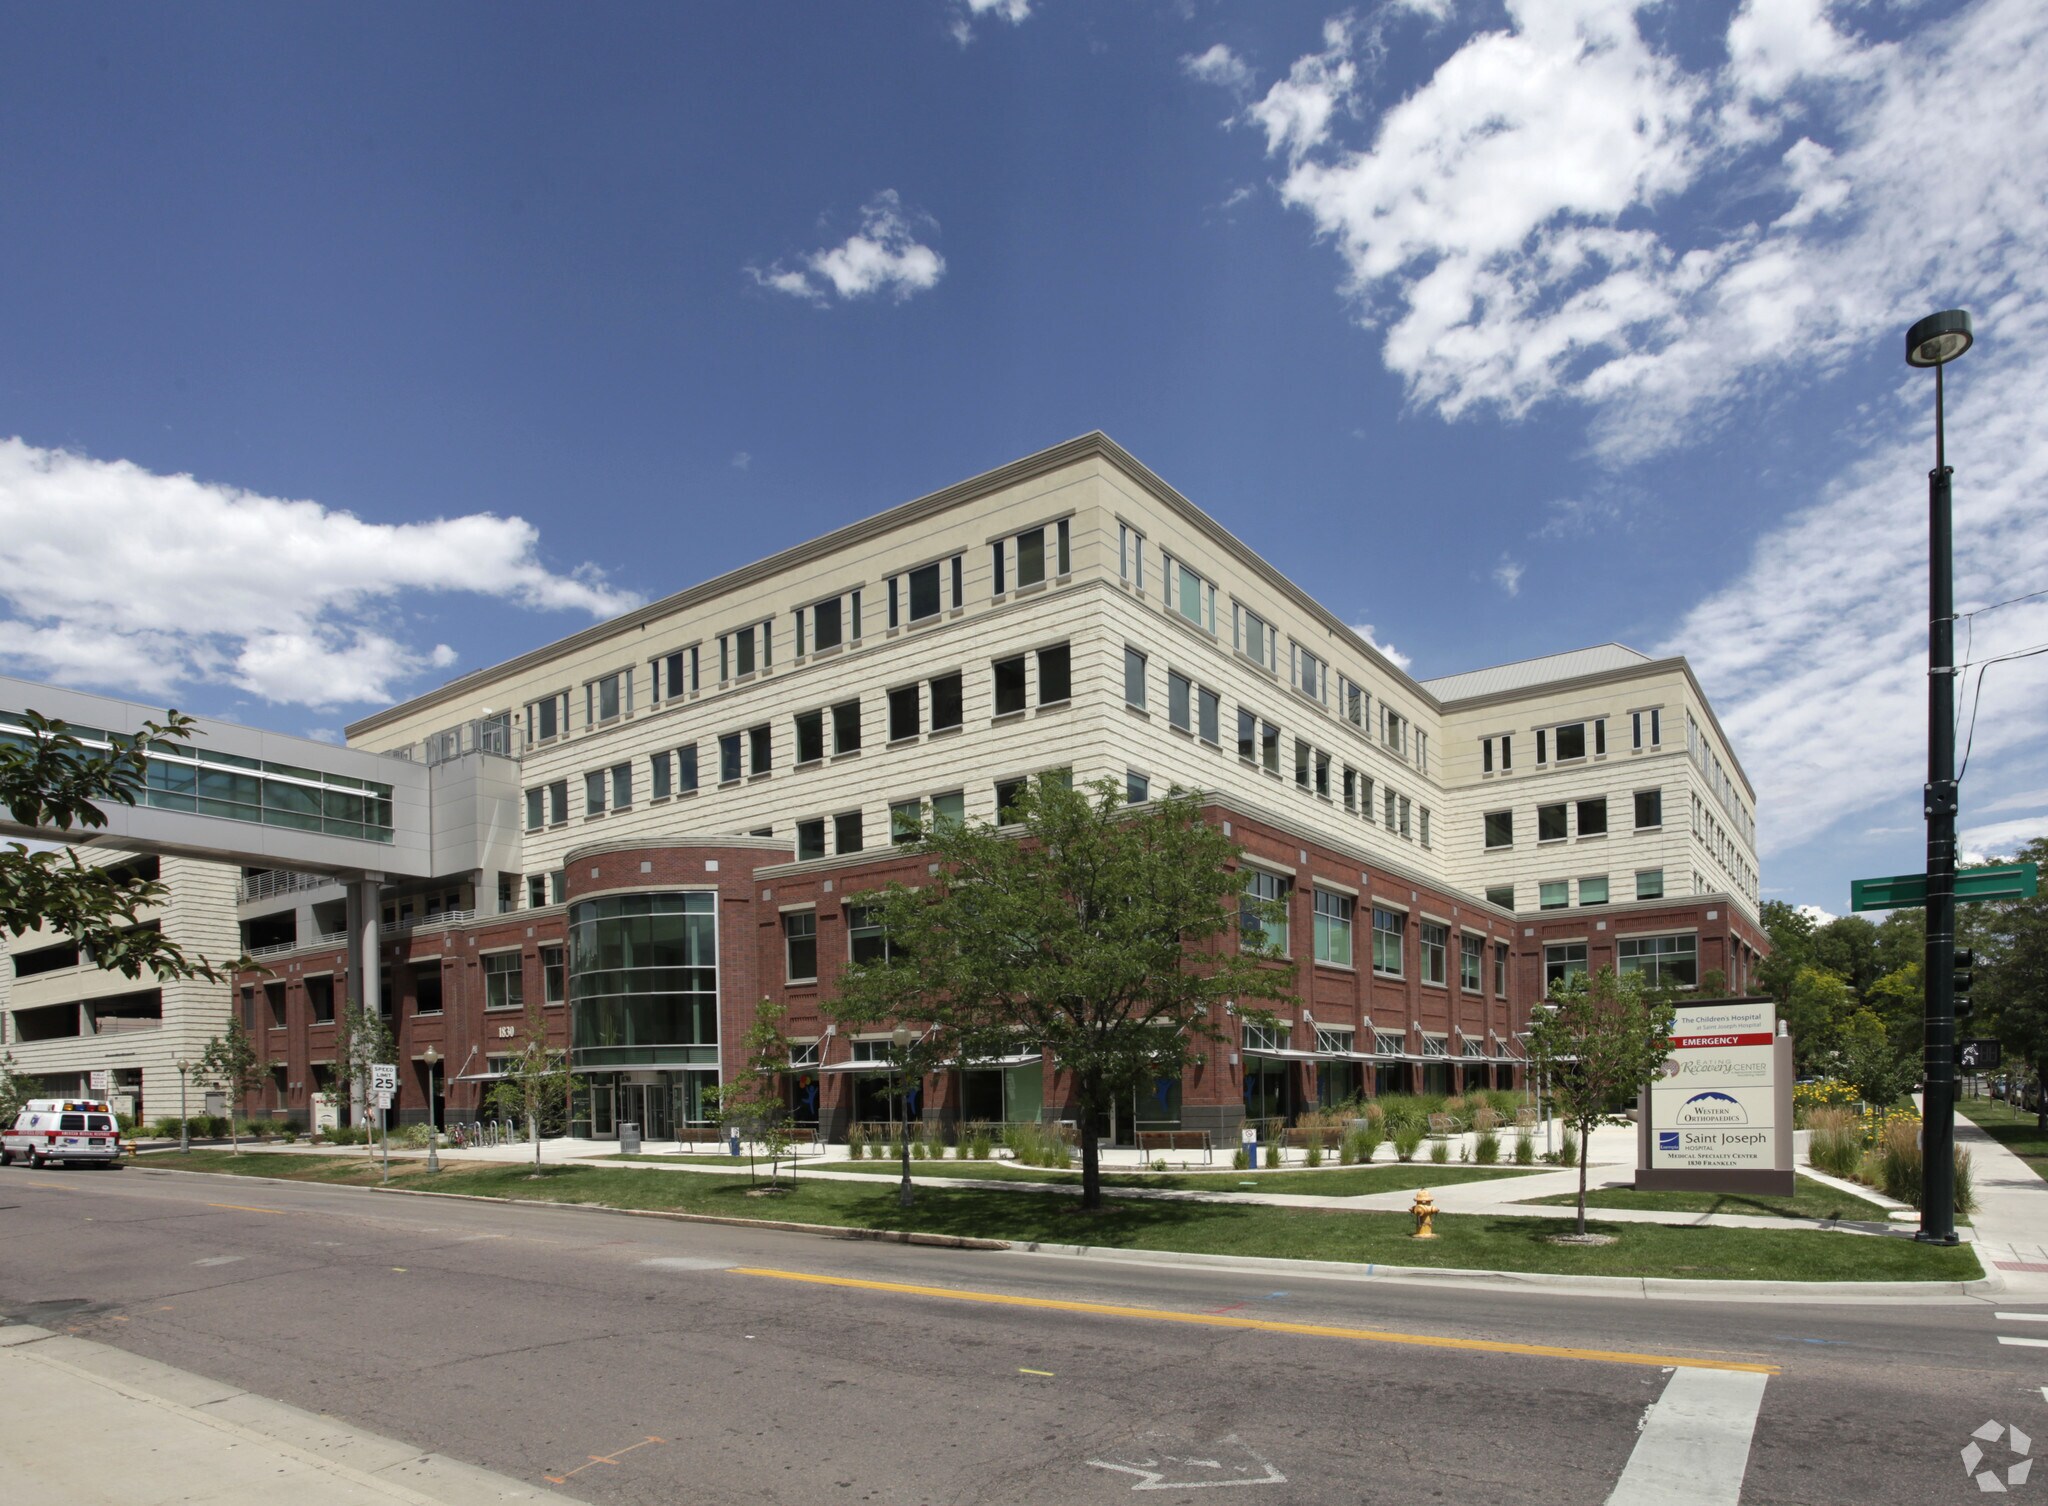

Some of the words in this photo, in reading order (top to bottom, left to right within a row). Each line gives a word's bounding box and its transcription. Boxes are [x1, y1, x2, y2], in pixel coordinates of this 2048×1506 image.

[1695, 1015, 1730, 1023] Children's
[1731, 1013, 1762, 1022] Hospital
[498, 1025, 515, 1038] 1830
[1717, 1023, 1738, 1031] Joseph
[1682, 1036, 1739, 1046] EMERGENCY
[1681, 1061, 1733, 1076] Recovery
[1733, 1063, 1767, 1071] CENTER
[375, 1078, 394, 1089] 25
[1694, 1107, 1730, 1115] WESTERN
[1684, 1114, 1740, 1122] ORTHOPAEDICS
[1685, 1133, 1717, 1144] Saint
[1721, 1132, 1767, 1146] Joseph
